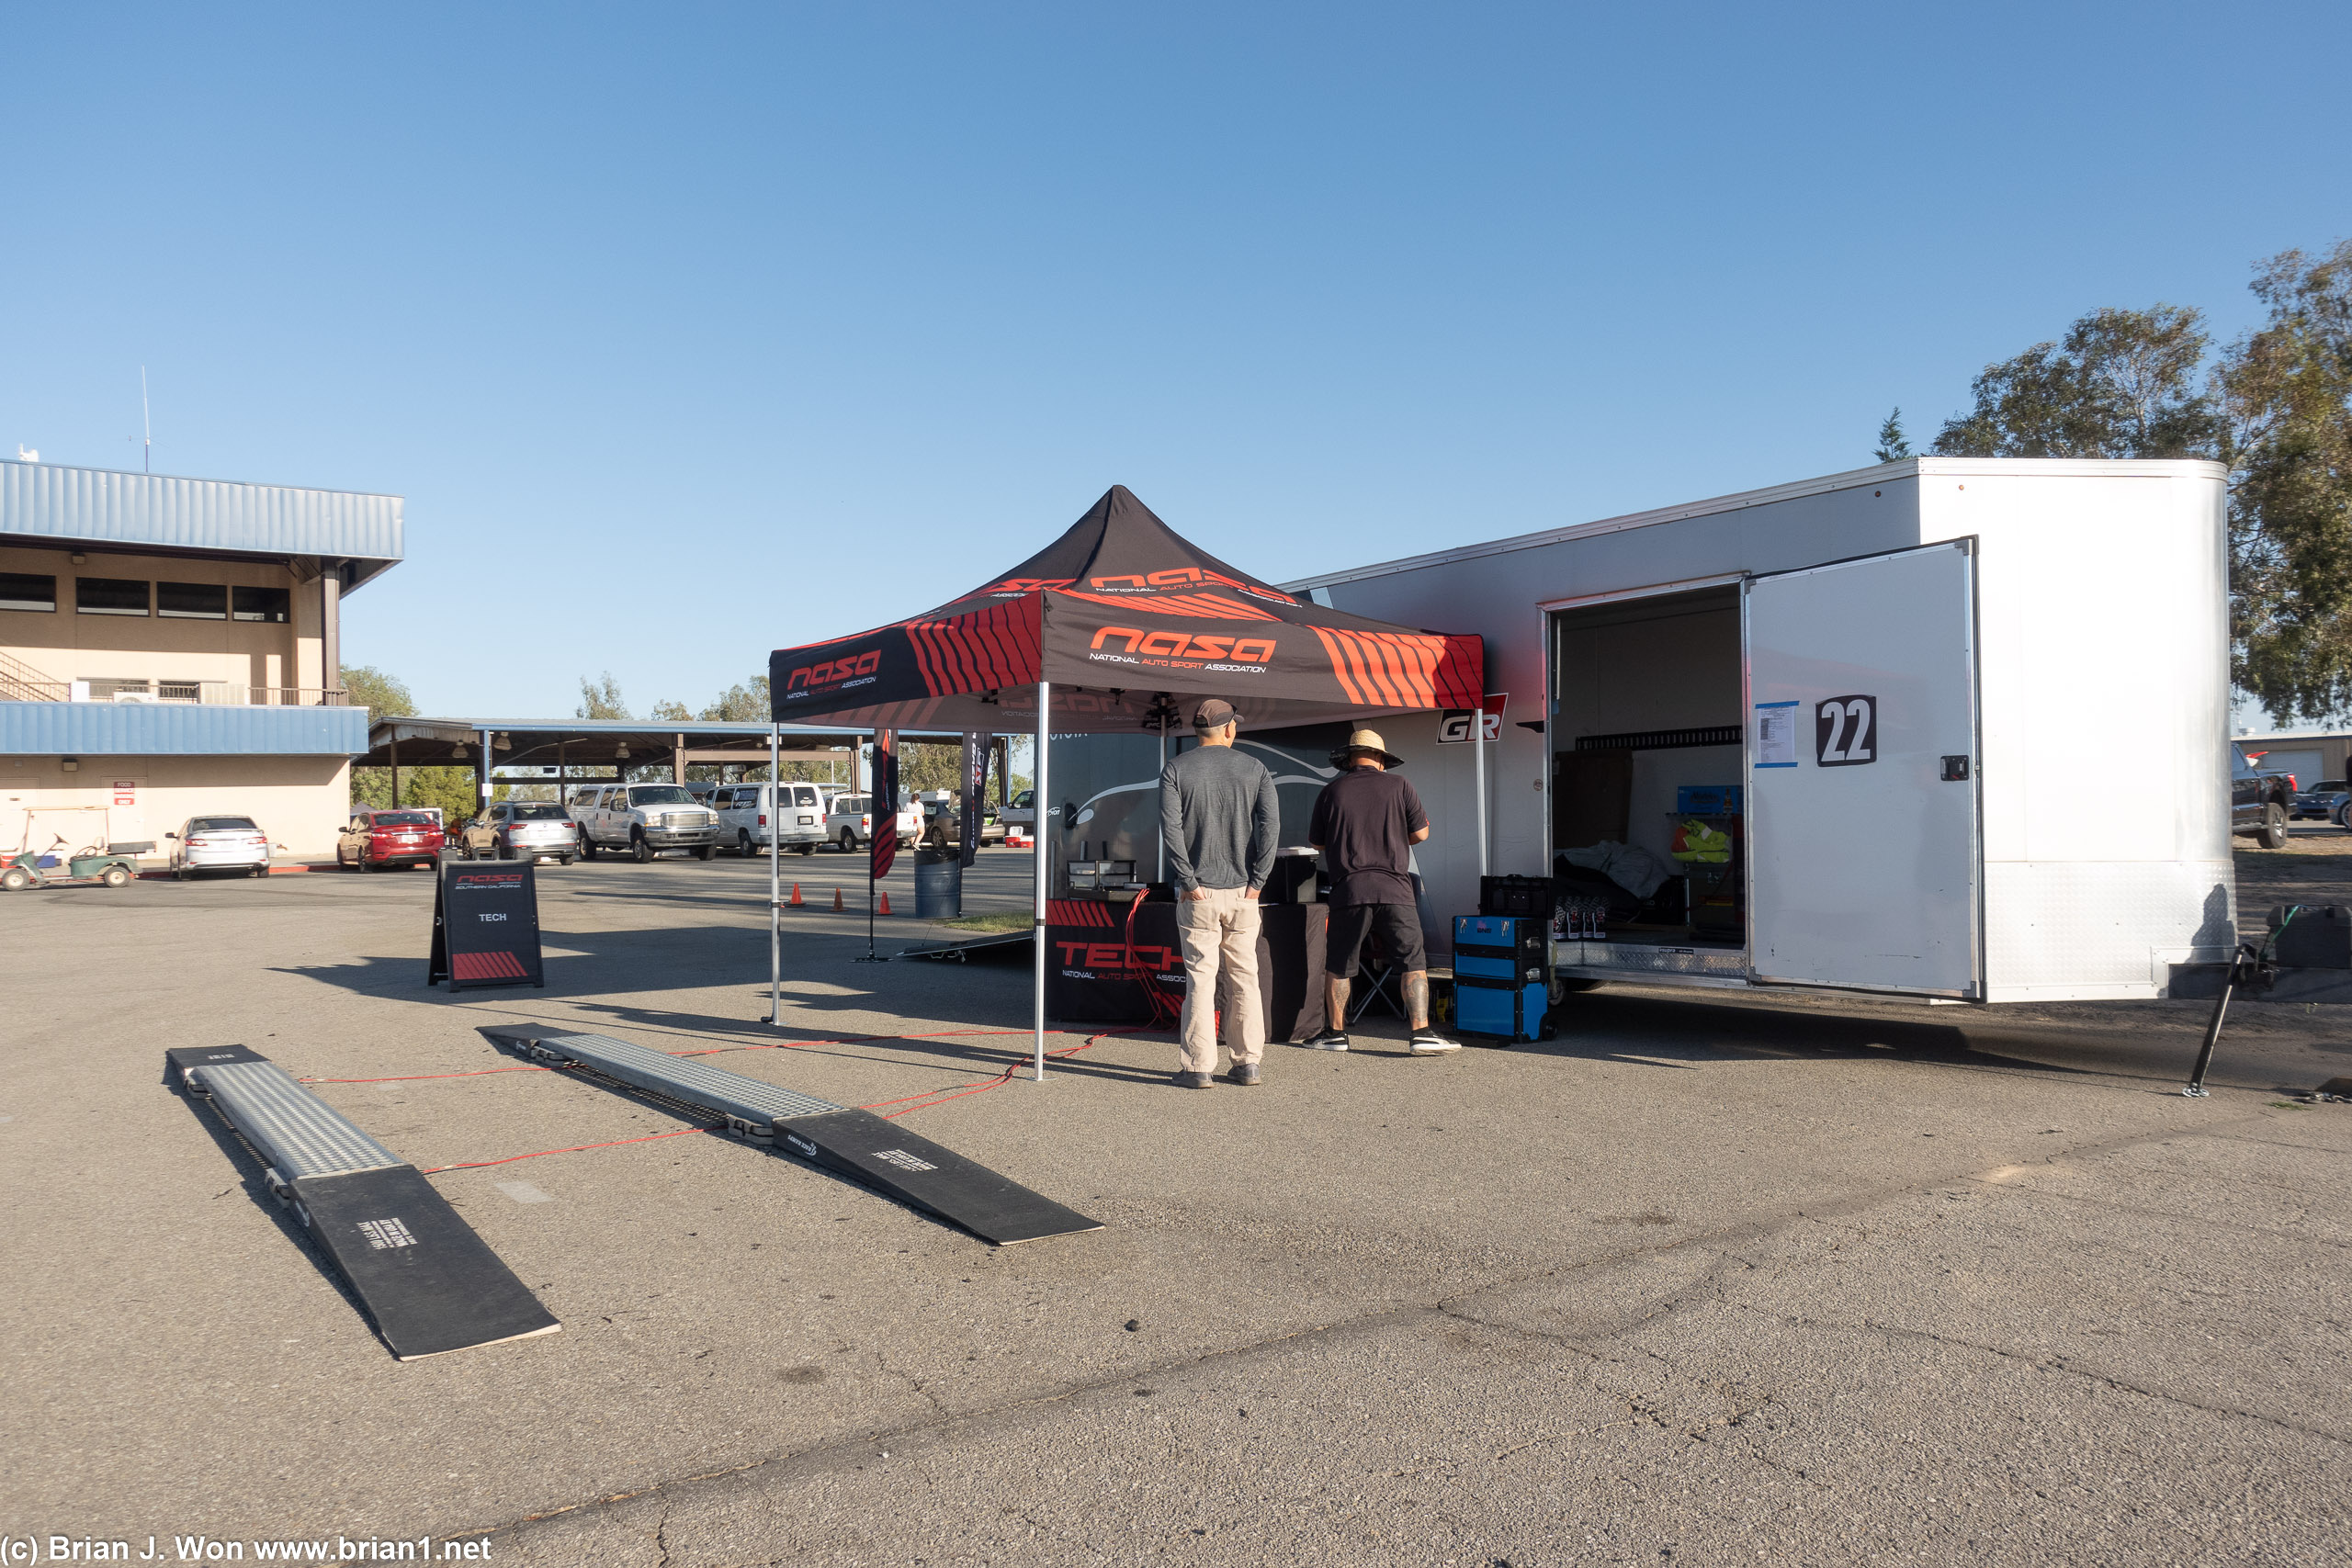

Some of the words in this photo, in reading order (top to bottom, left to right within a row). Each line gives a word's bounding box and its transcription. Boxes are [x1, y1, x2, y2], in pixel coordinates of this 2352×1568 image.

[1159, 582, 1189, 592] AUTO
[1090, 626, 1277, 662] nasa
[787, 649, 882, 690] nasa
[1089, 652, 1140, 664] NATIONAL
[1141, 658, 1169, 667] AUTO
[1170, 660, 1204, 670] SPORT
[1204, 662, 1267, 674] ASSOCIATION
[786, 690, 809, 699] NATIONAL
[841, 676, 876, 689] ASSOCIATION
[1440, 714, 1500, 741] GR
[1821, 699, 1871, 761] 22
[457, 874, 524, 883] nasa
[479, 913, 507, 921] TECH
[1062, 969, 1095, 979] NATIONAL
[1156, 974, 1186, 983] ASSOC
